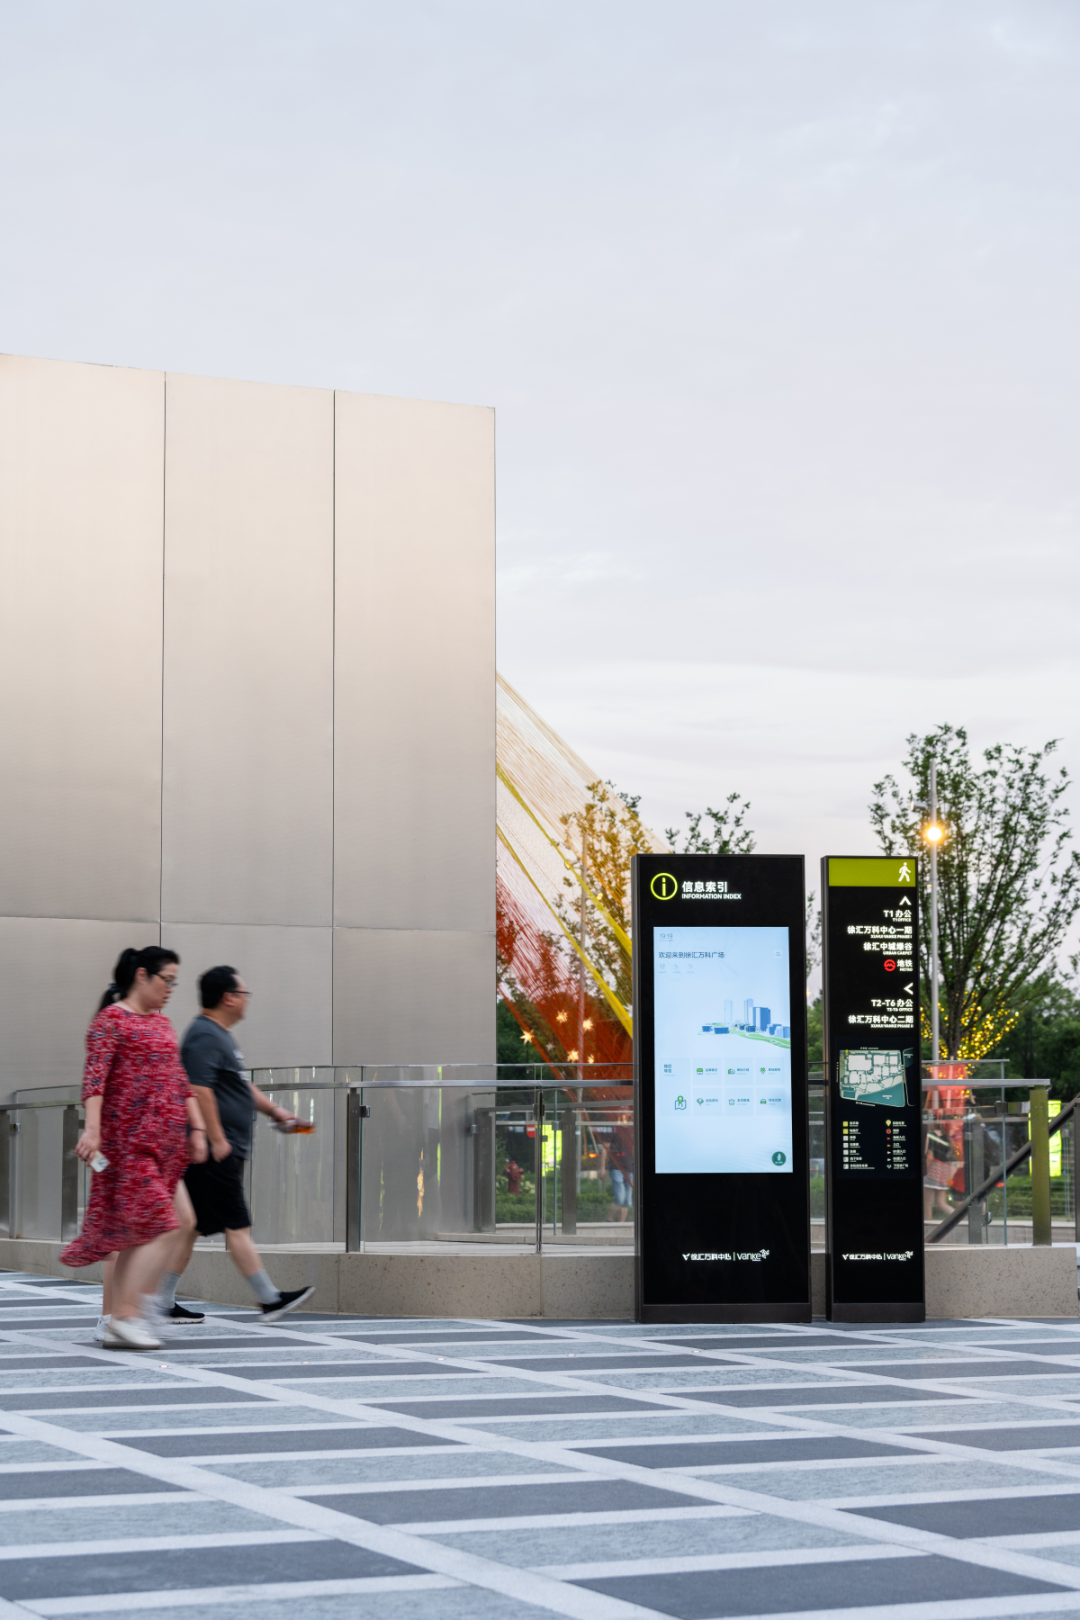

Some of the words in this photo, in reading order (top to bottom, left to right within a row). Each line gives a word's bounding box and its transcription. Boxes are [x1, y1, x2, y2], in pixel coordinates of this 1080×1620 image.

[682, 881, 728, 893] 信息索引
[883, 910, 894, 918] T1
[895, 909, 912, 918] 办公
[847, 925, 913, 934] 徐汇万科中心一期
[658, 951, 725, 959] 欢迎来到徐汇万科广场
[896, 959, 913, 968] 地铁
[870, 999, 896, 1007] T2-T6
[896, 999, 914, 1008] 办公
[848, 1015, 914, 1024] 徐汇万科中心二期
[736, 1252, 762, 1261] vanke
